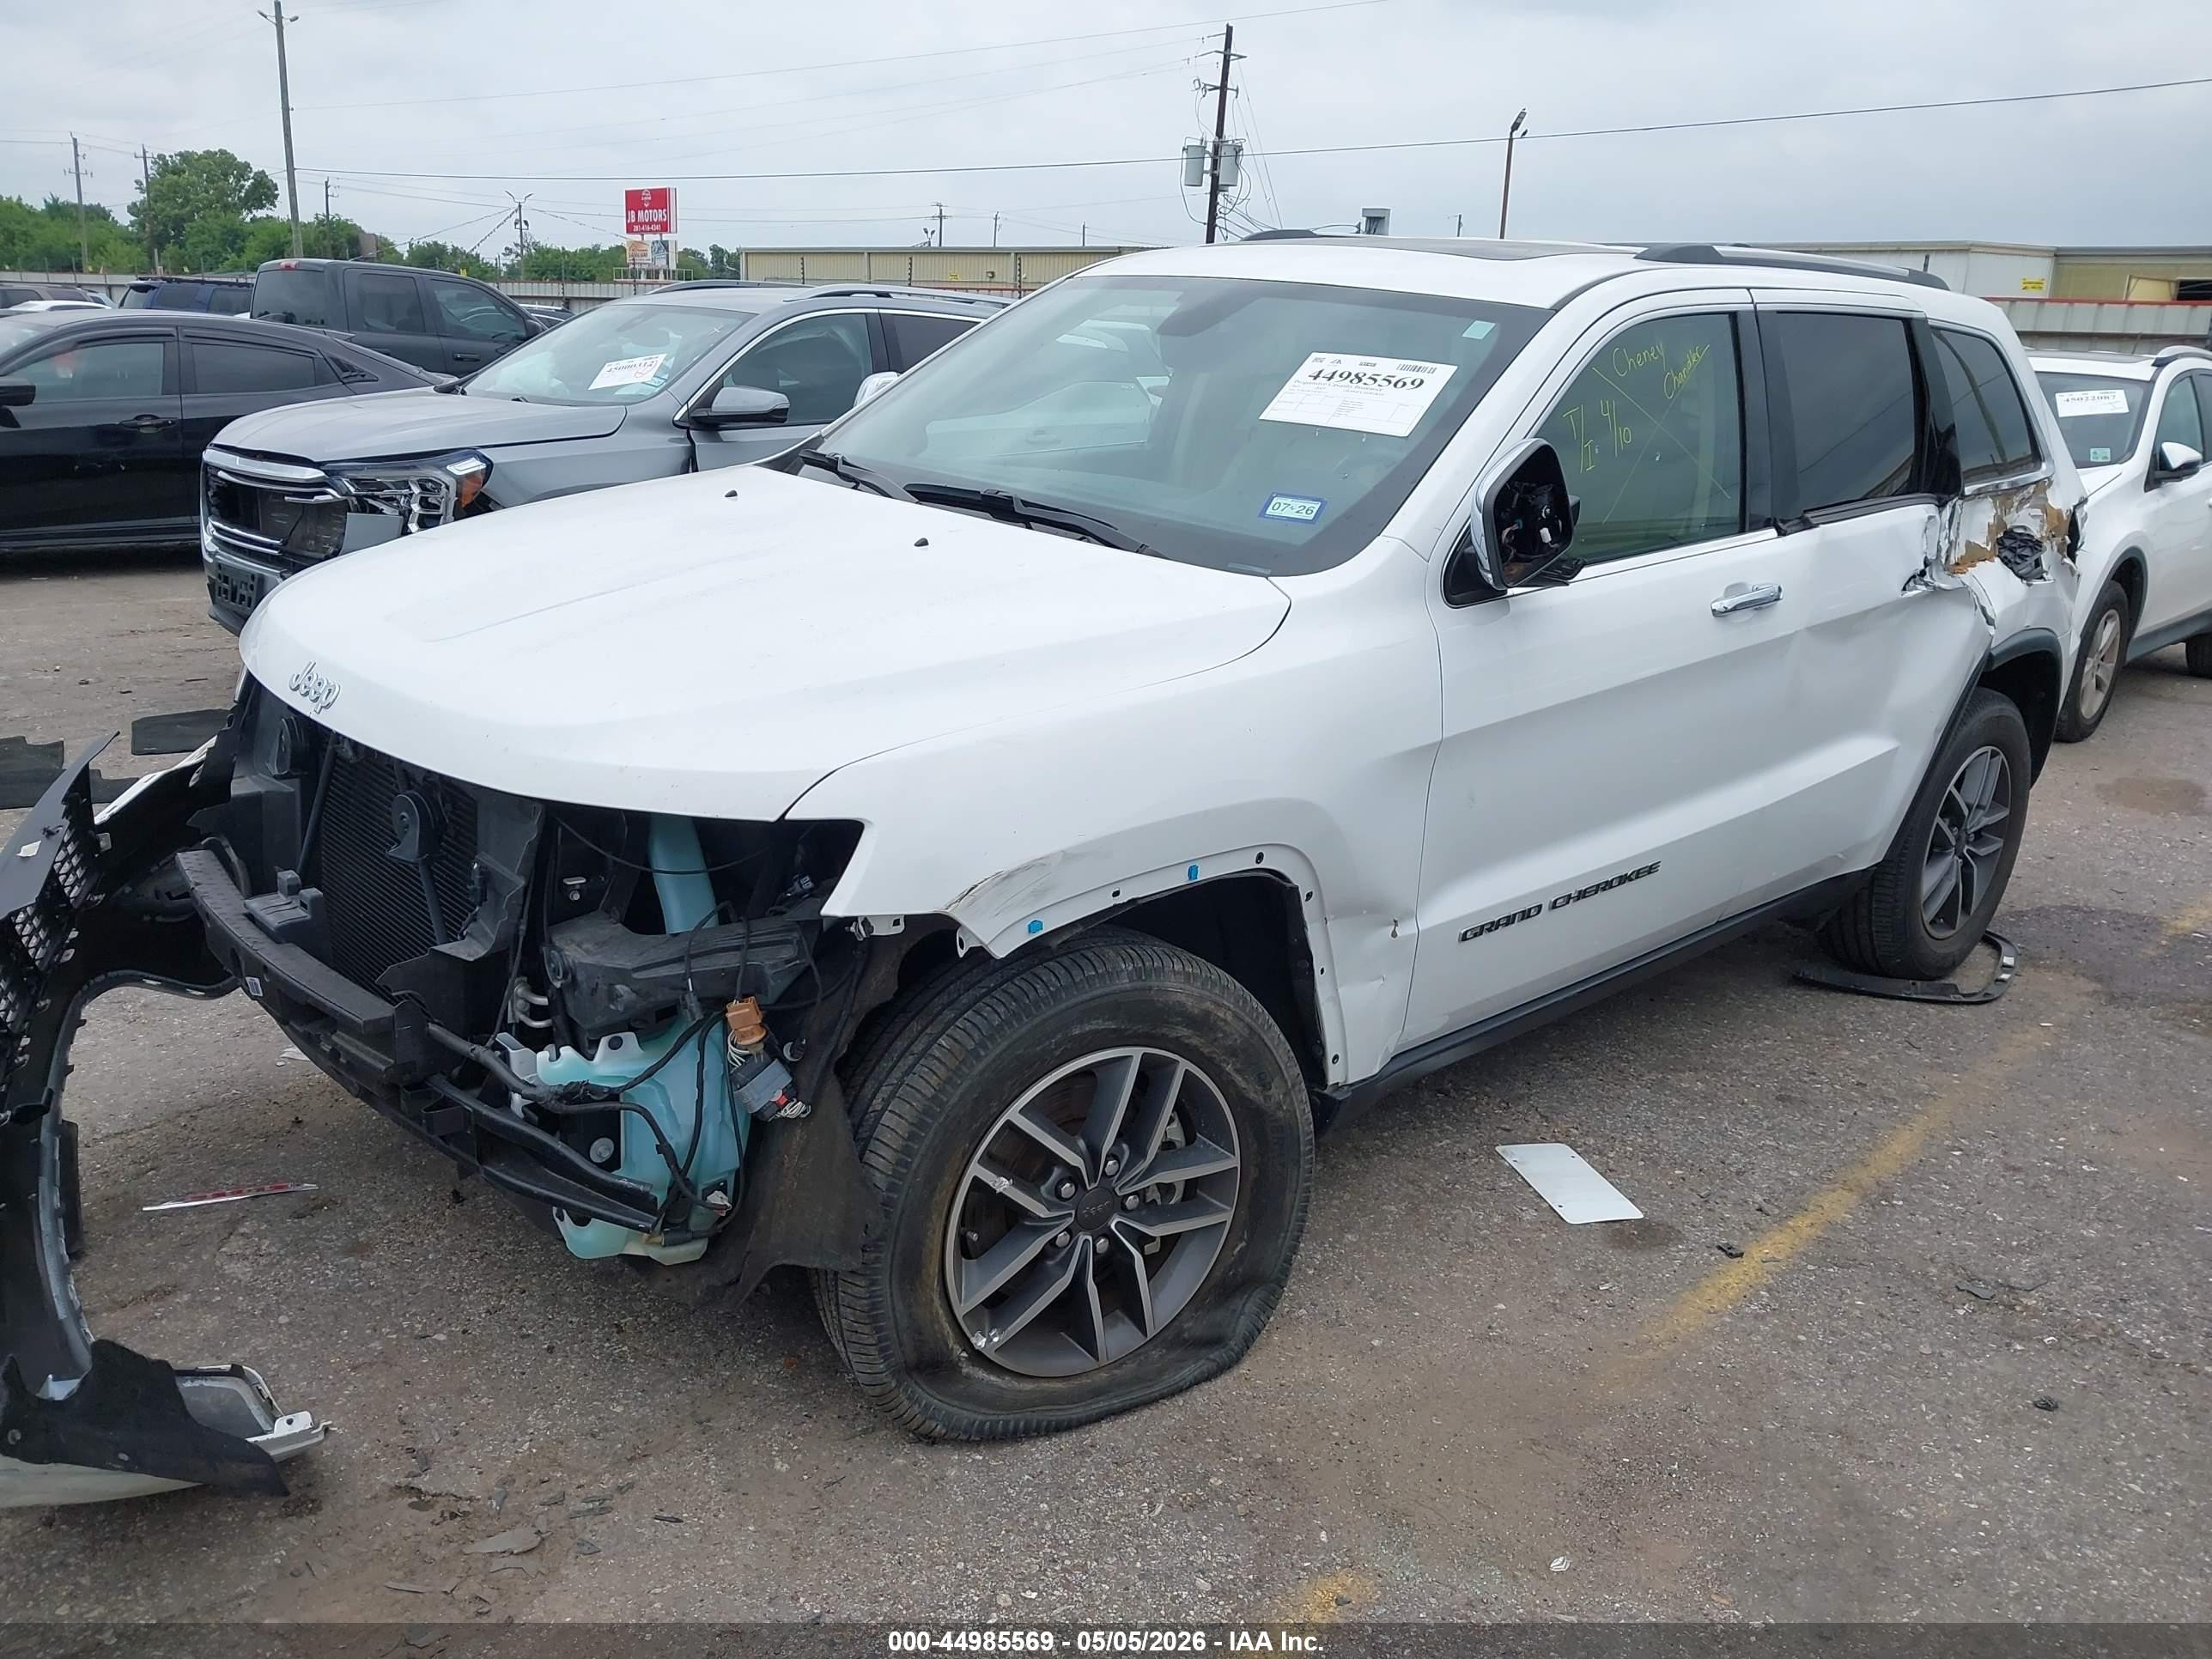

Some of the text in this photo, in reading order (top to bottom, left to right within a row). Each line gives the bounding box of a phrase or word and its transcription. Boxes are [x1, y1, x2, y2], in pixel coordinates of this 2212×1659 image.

[628, 209, 667, 223] JB MOTORS
[1613, 342, 1667, 377] Cheney
[1308, 368, 1425, 391] 44985569
[289, 660, 341, 714] Jeep
[1458, 860, 1662, 943] GRAND CHEROKEE
